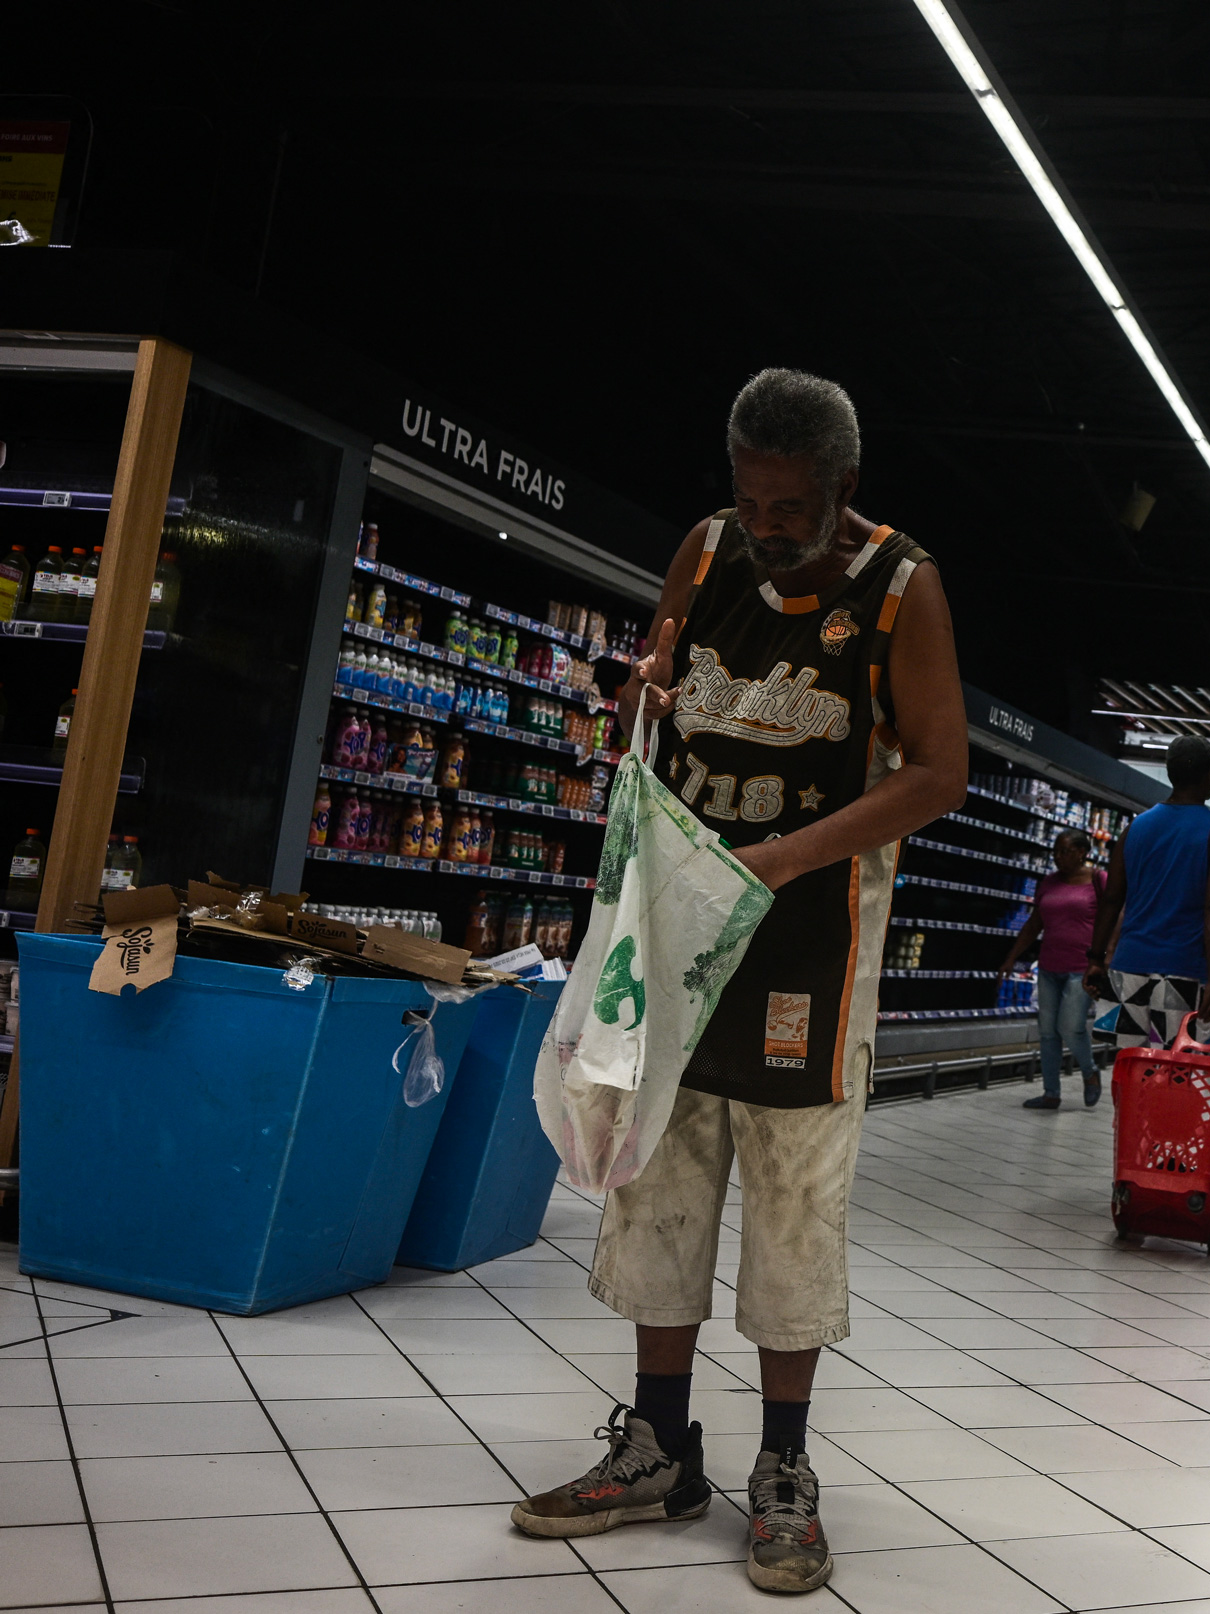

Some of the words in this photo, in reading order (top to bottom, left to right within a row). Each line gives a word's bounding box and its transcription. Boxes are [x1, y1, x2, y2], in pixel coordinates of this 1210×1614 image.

[402, 398, 488, 475] ULTRA
[496, 449, 566, 511] FRAIS
[674, 643, 851, 746] Brooklyn
[989, 705, 1013, 732] ULTRA
[1013, 717, 1034, 742] FRAIS
[681, 752, 785, 823] 718
[116, 926, 153, 976] Sojasun
[297, 919, 347, 939] Sojasun
[767, 1058, 804, 1068] 1979
